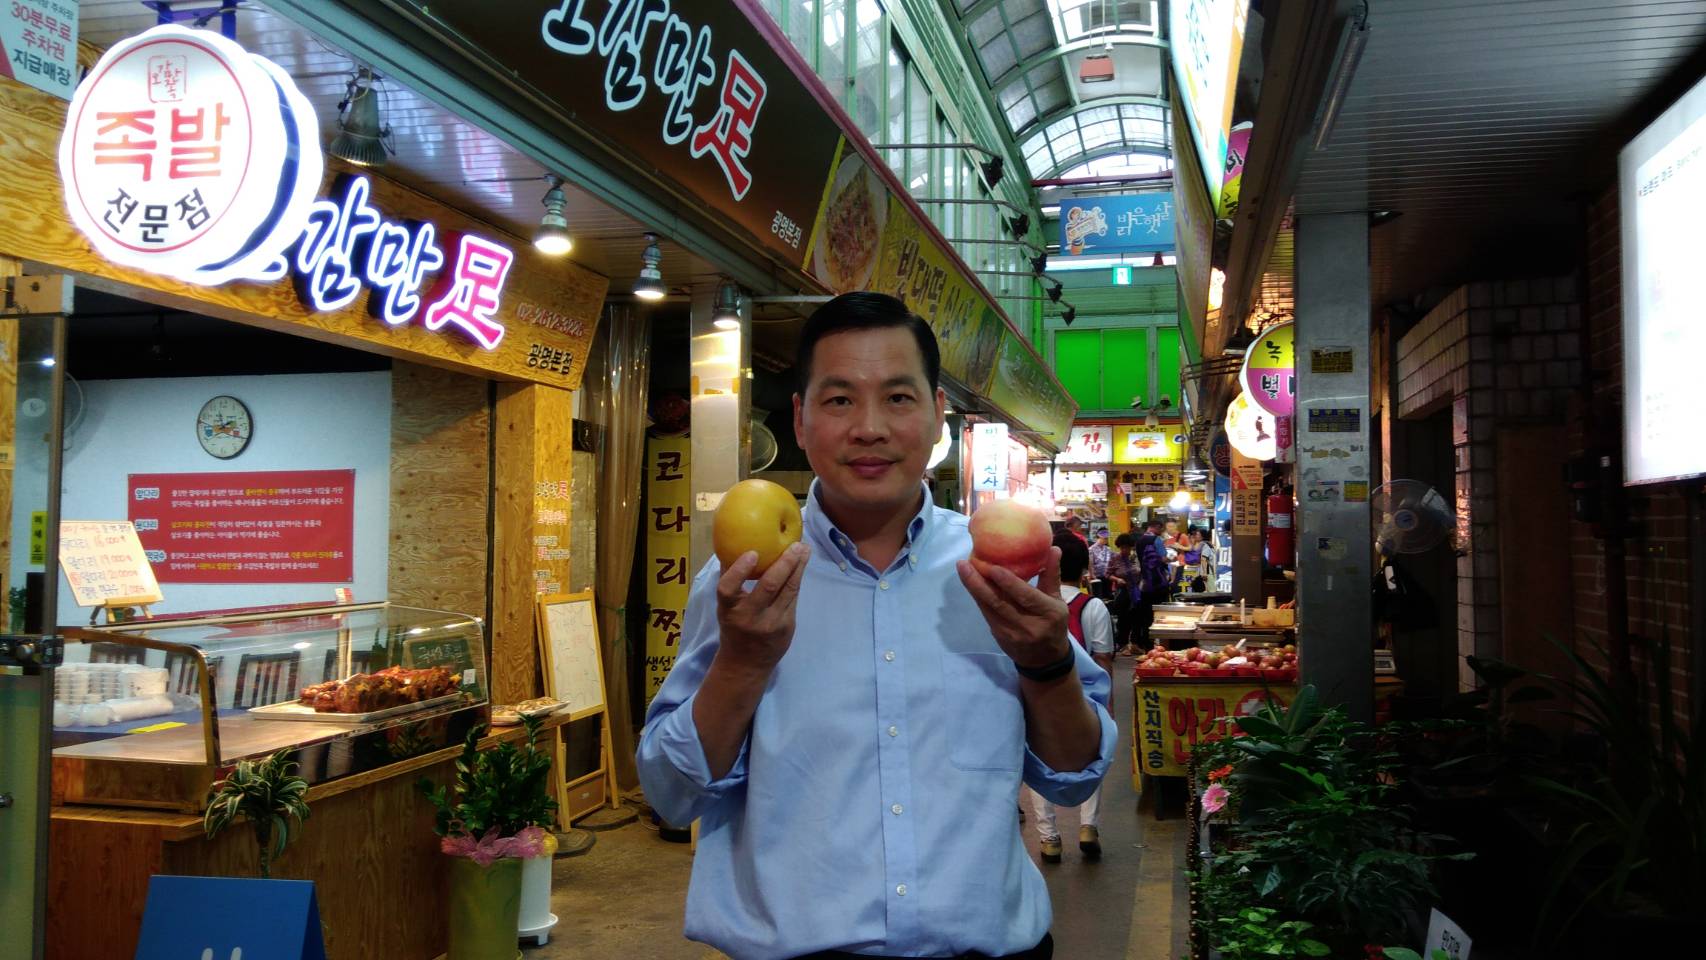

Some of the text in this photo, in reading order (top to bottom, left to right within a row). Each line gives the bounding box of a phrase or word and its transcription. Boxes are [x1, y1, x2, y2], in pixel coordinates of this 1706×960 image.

[22, 28, 66, 61] 주차권
[13, 48, 72, 86] 지급매장
[94, 102, 231, 182] 족발
[103, 187, 212, 243] 전문점
[771, 210, 802, 249] 광명본점
[527, 344, 573, 375] 광명본점
[135, 488, 159, 499] 앞다리
